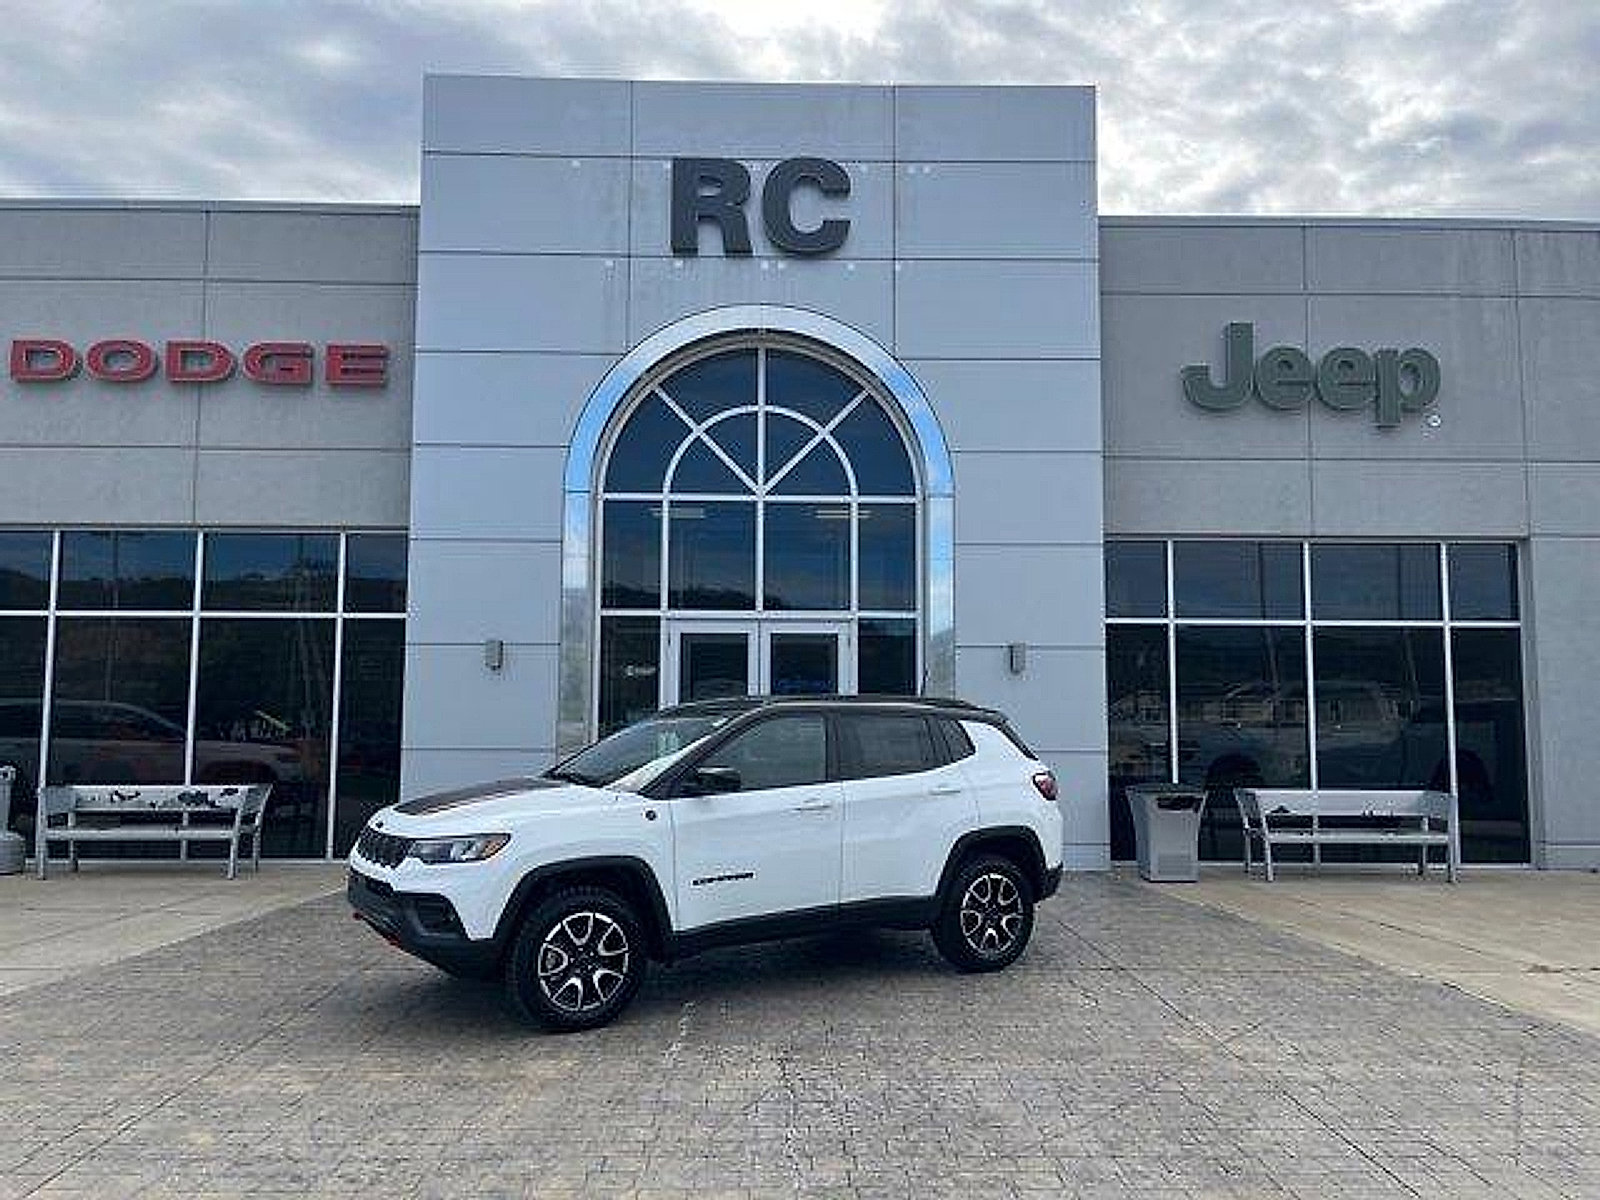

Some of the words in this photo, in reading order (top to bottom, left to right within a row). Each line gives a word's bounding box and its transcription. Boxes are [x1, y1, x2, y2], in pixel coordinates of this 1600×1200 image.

[670, 157, 851, 258] RC
[10, 340, 390, 386] DODGE
[1181, 322, 1441, 429] Jeep
